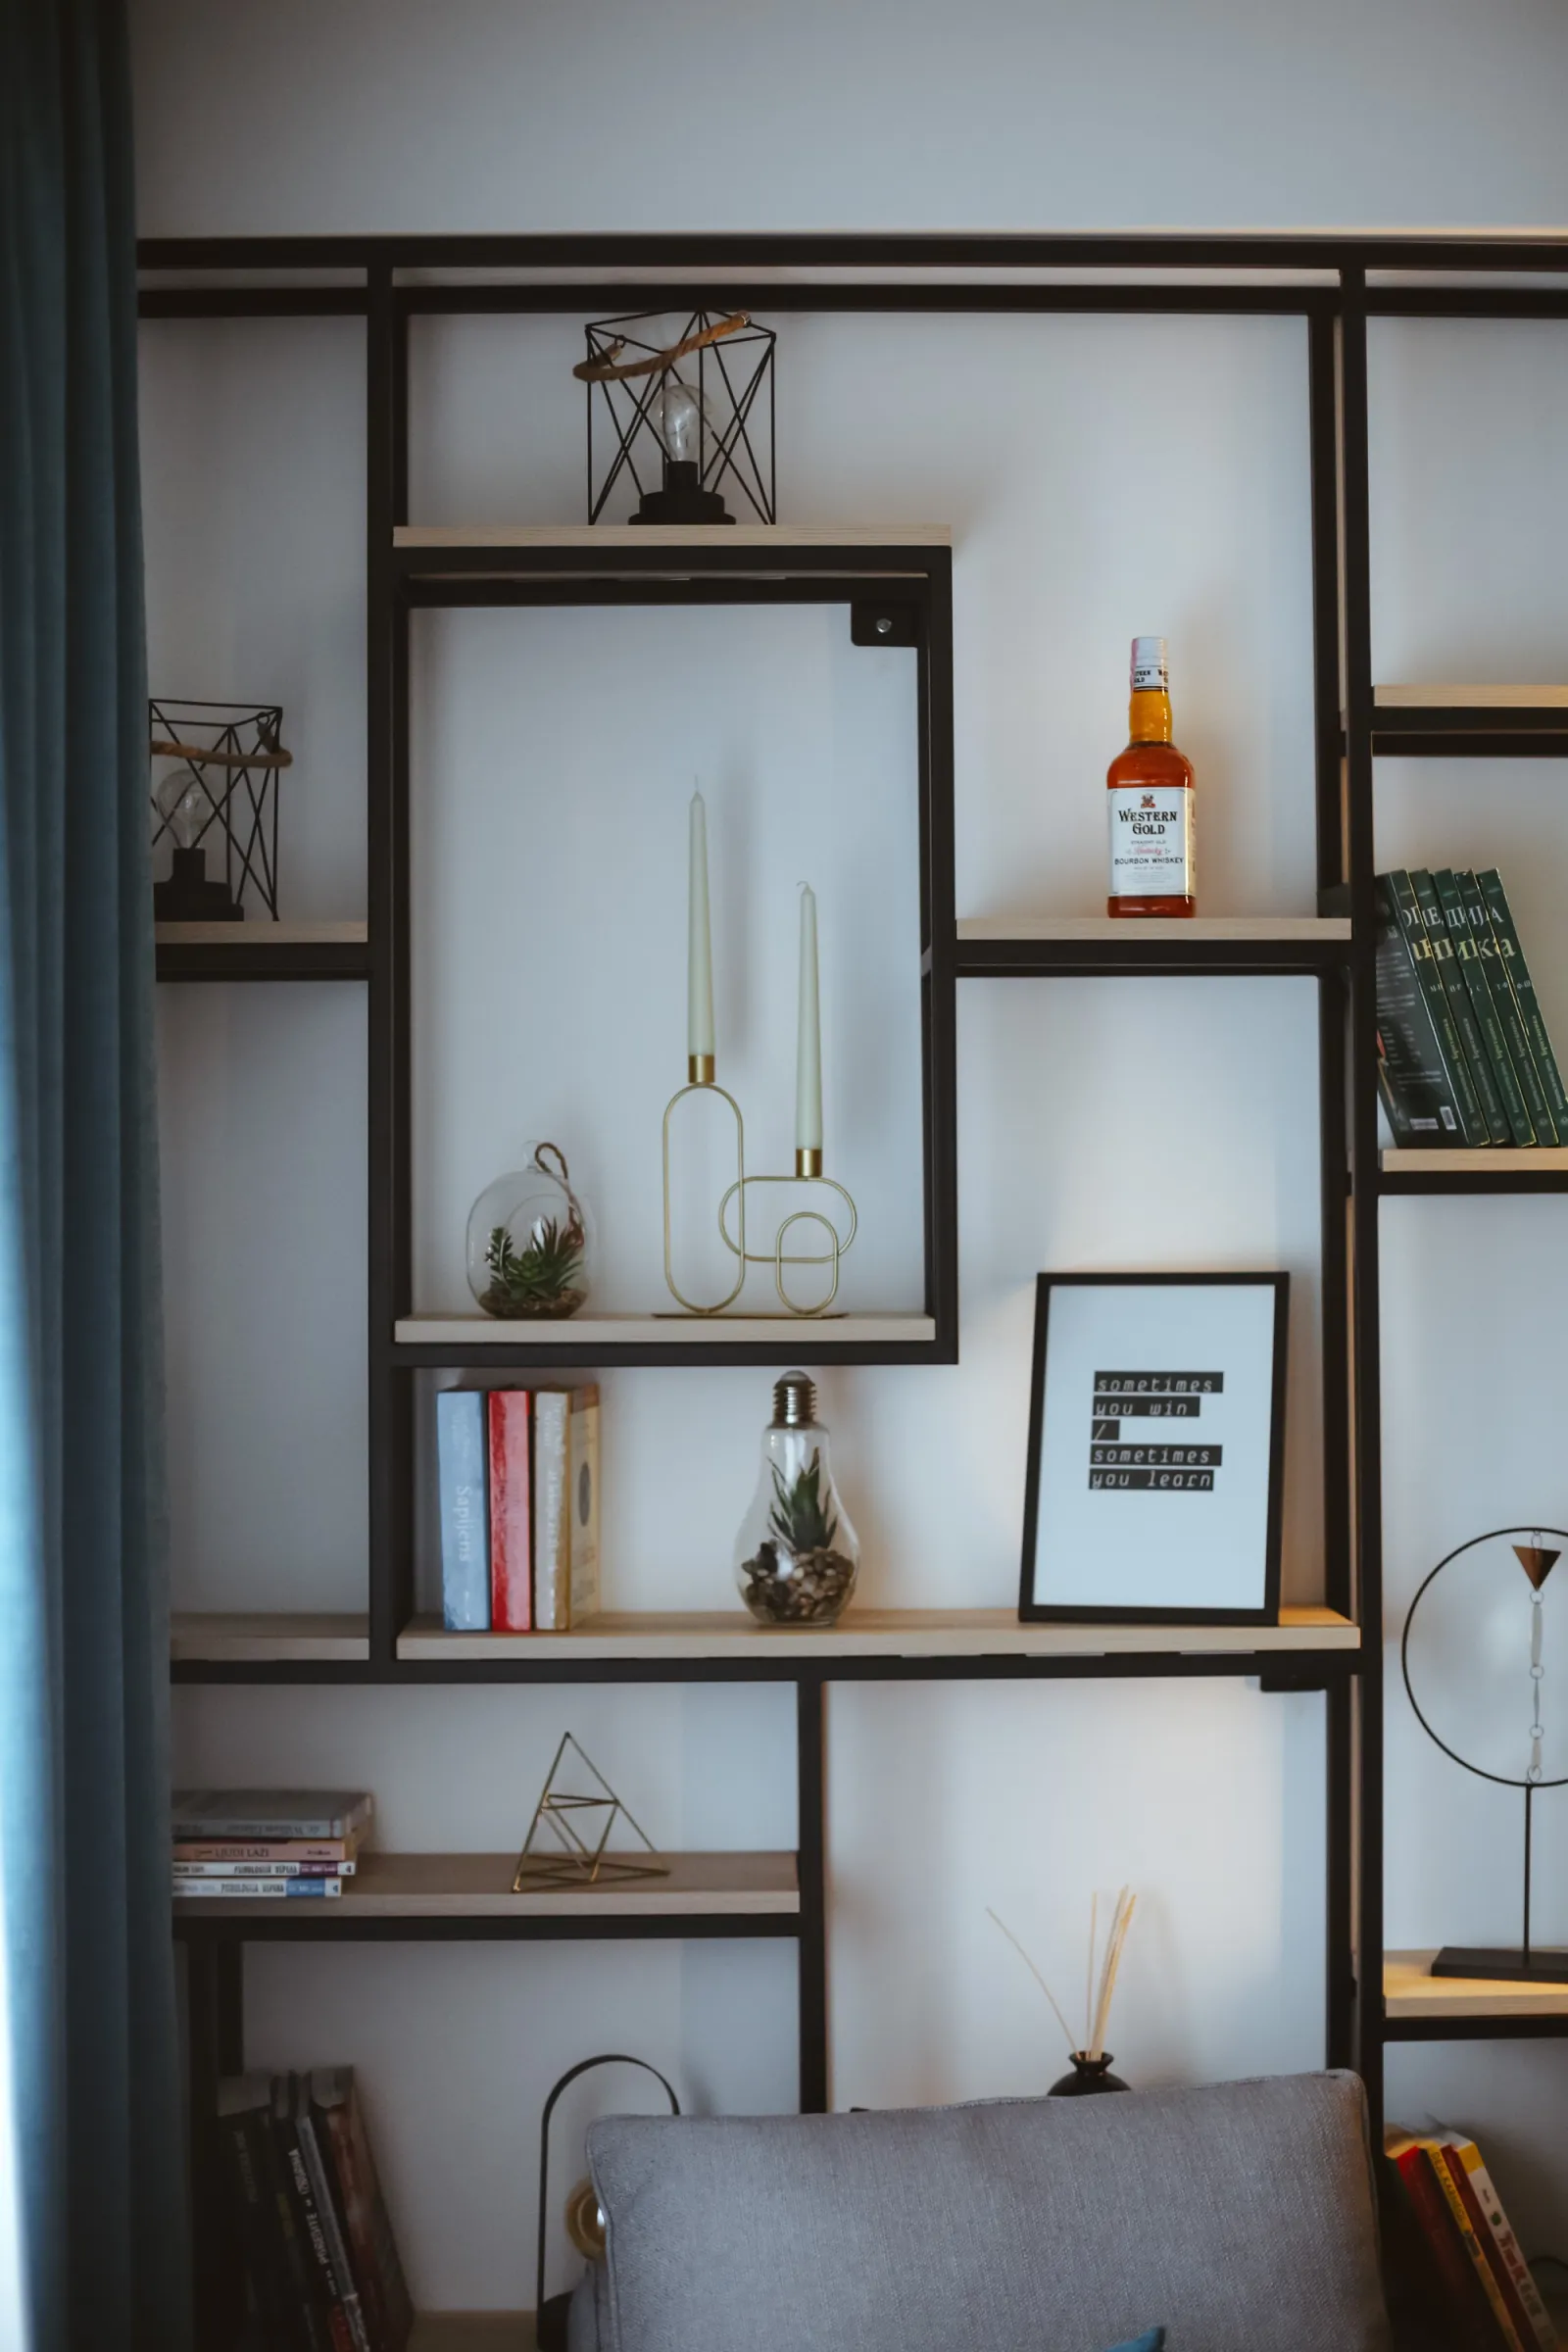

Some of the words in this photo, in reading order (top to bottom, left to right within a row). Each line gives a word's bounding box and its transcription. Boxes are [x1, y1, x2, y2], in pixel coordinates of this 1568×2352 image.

[1118, 808, 1178, 822] WESTERN
[1132, 823, 1165, 835] GOLD
[1097, 1377, 1212, 1393] sometimes
[1095, 1401, 1134, 1417] you
[1149, 1399, 1188, 1416] win
[1094, 1446, 1210, 1463] sometimes
[1091, 1472, 1130, 1489] you
[1147, 1470, 1212, 1488] learn
